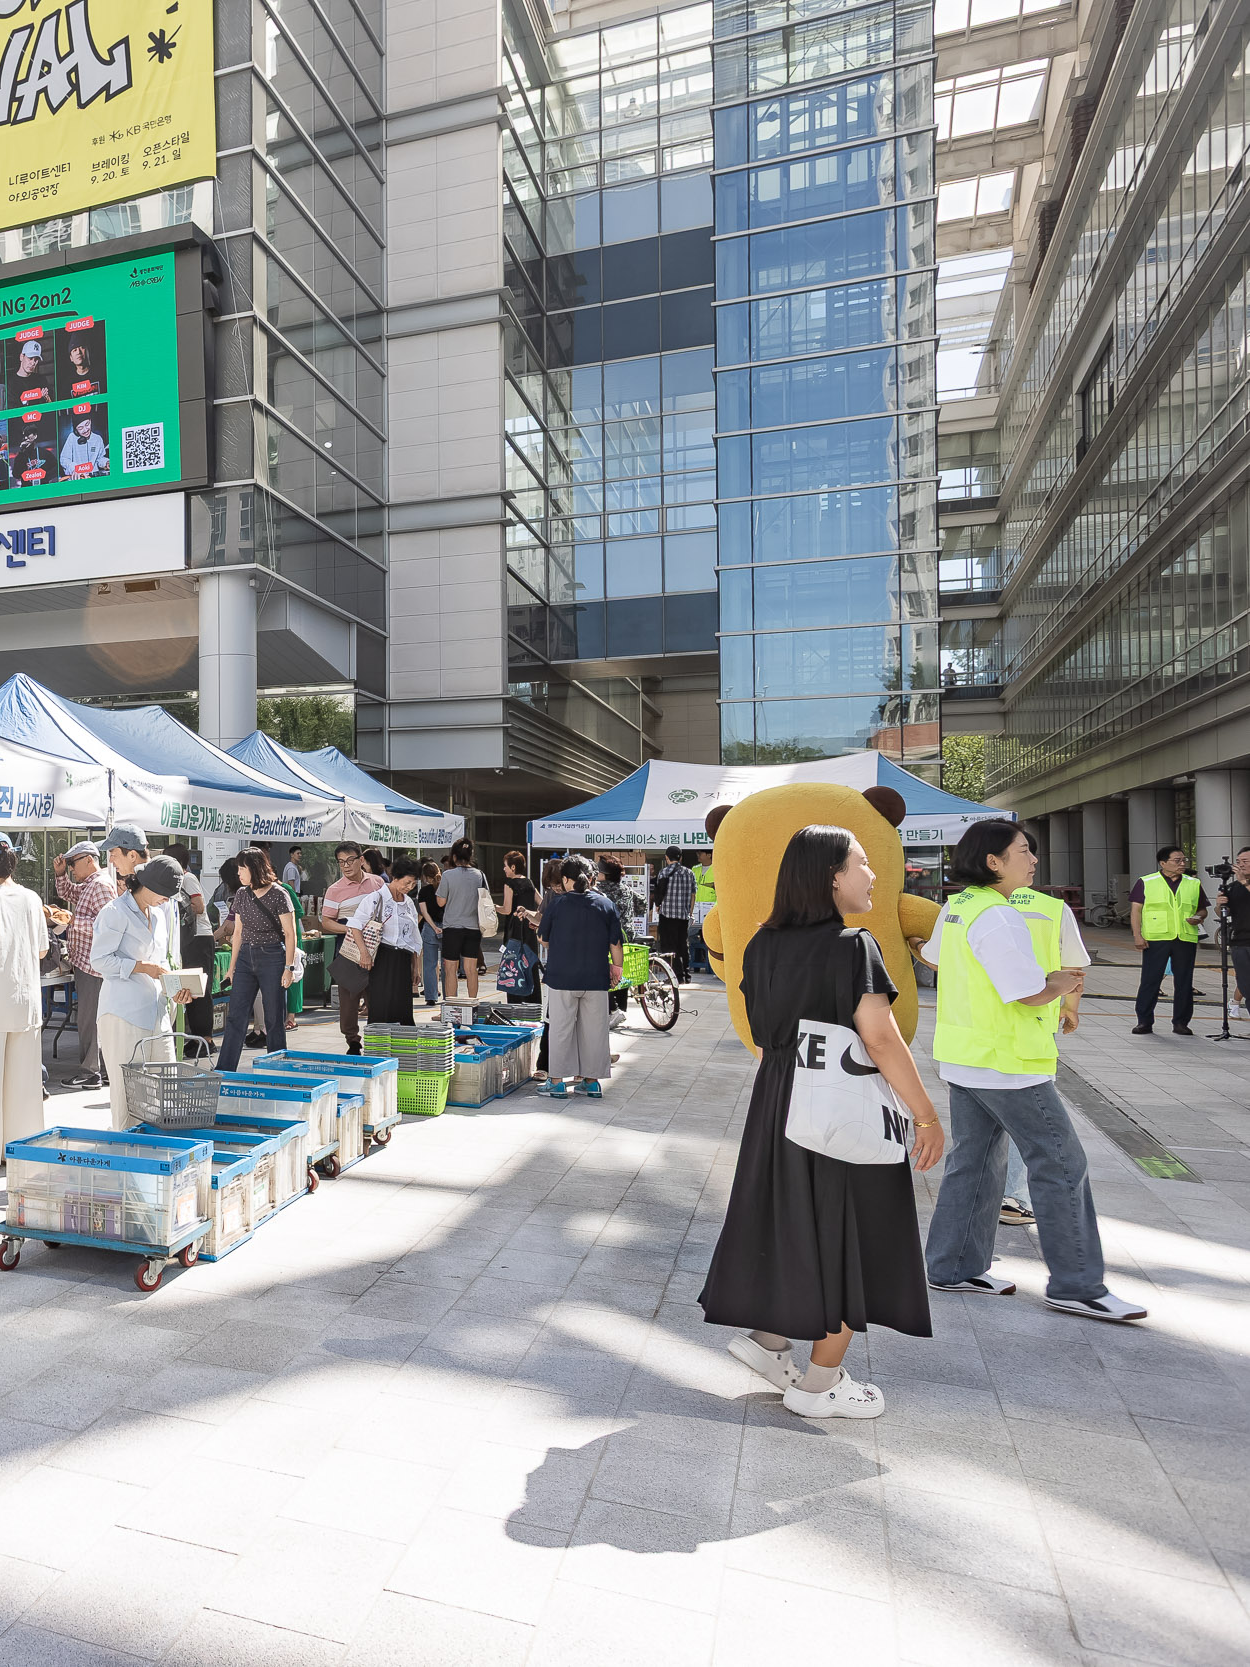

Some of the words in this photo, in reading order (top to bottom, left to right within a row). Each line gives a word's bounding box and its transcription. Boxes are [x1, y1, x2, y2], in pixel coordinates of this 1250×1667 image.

[91, 135, 106, 147] 후원
[126, 125, 141, 138] KB
[142, 114, 172, 131] 국민은행
[142, 131, 190, 158] 오픈스타일
[91, 153, 130, 173] 브레이킹
[154, 154, 169, 168] 21.
[172, 148, 182, 161] 일
[8, 162, 71, 186] 나루아트센터
[101, 170, 117, 182] 20.
[120, 166, 130, 177] 토
[8, 183, 60, 203] 야외공연장
[29, 287, 72, 315] 2on2
[19, 329, 39, 339] JUDGE
[69, 319, 90, 330] JUDGE
[16, 792, 55, 819] 바자회
[161, 801, 224, 833] 아름다운가게와
[225, 813, 251, 835] 함께하는
[252, 814, 294, 836] Beautiful
[585, 833, 657, 845] 메이커스페이스
[659, 833, 680, 845] 체험
[683, 832, 714, 845] 나만
[906, 829, 943, 841] 만들기
[796, 1031, 827, 1070] KE
[881, 1104, 909, 1147] NI
[69, 1155, 111, 1168] 아름다운가게
